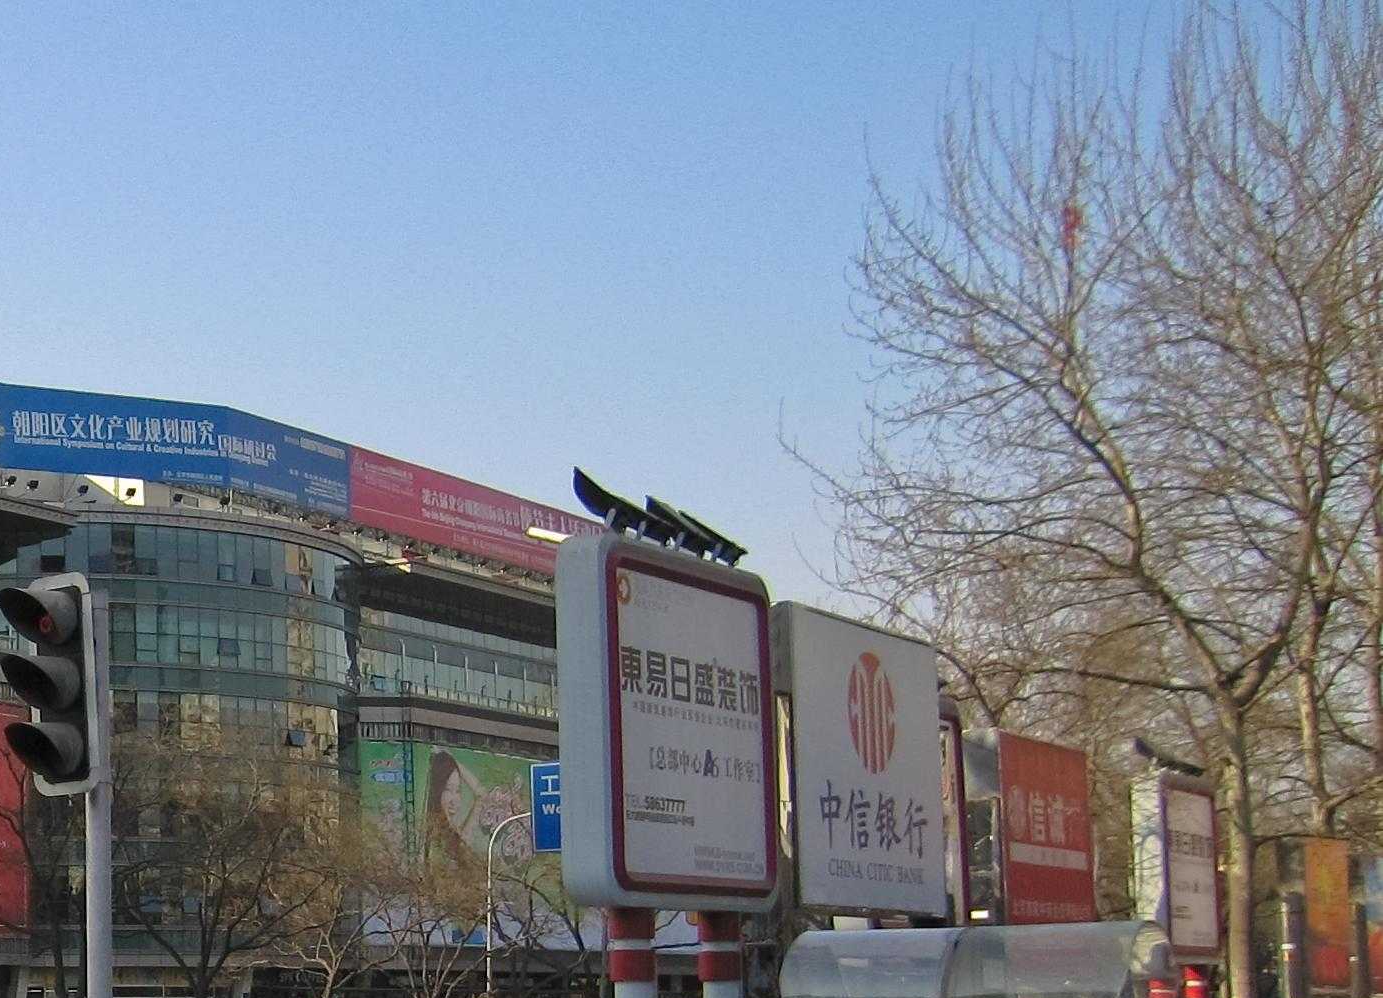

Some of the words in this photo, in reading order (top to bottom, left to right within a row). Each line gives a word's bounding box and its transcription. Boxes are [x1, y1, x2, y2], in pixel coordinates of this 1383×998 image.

[12, 410, 215, 445] 朝阳区文化产业规划研究
[819, 779, 927, 859] 中信银行
[827, 857, 863, 879] CHINA
[867, 861, 893, 882] CITIC
[897, 865, 925, 885] BANK
